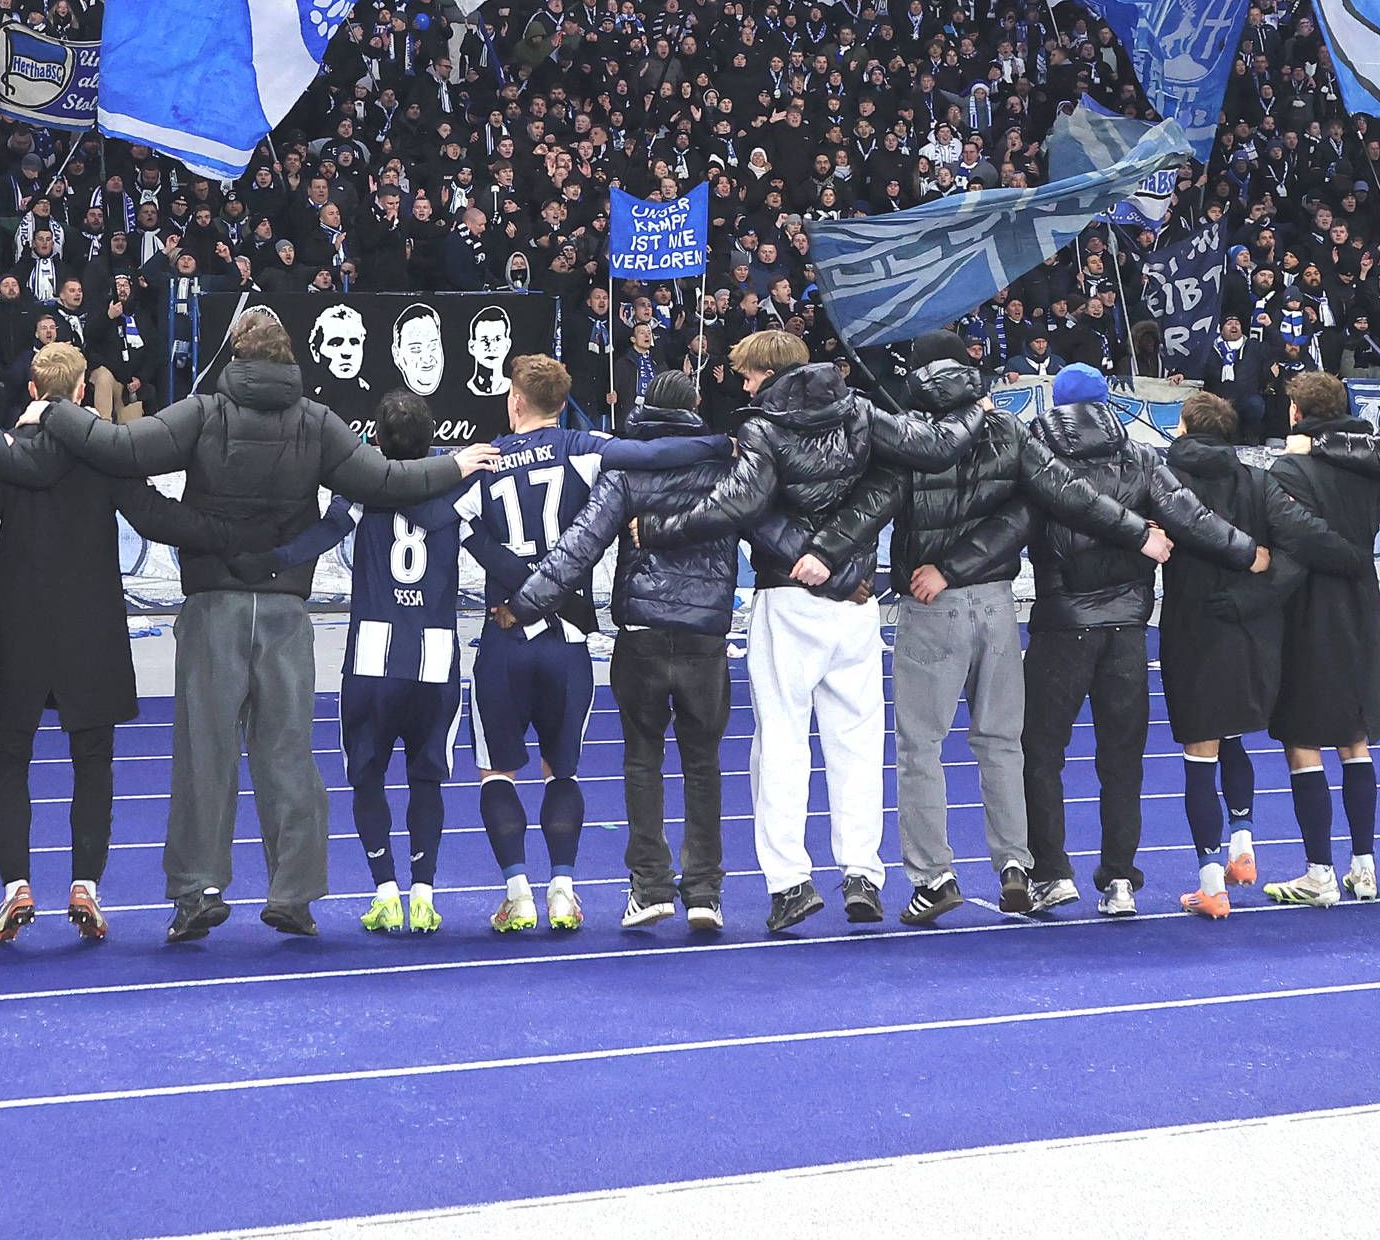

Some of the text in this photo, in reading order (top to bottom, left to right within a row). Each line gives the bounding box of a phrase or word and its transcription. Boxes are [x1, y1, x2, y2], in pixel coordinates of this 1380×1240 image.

[13, 56, 63, 83] HerthaBSC
[62, 93, 99, 111] Stol
[631, 197, 690, 219] UNSER
[634, 213, 688, 233] KAMPF
[630, 229, 697, 252] IST NIE
[611, 249, 703, 272] VERLOREN
[490, 444, 556, 474] HERTHA BSC
[488, 464, 566, 558] 17
[389, 510, 429, 585] 8
[393, 587, 424, 607] SESSA
